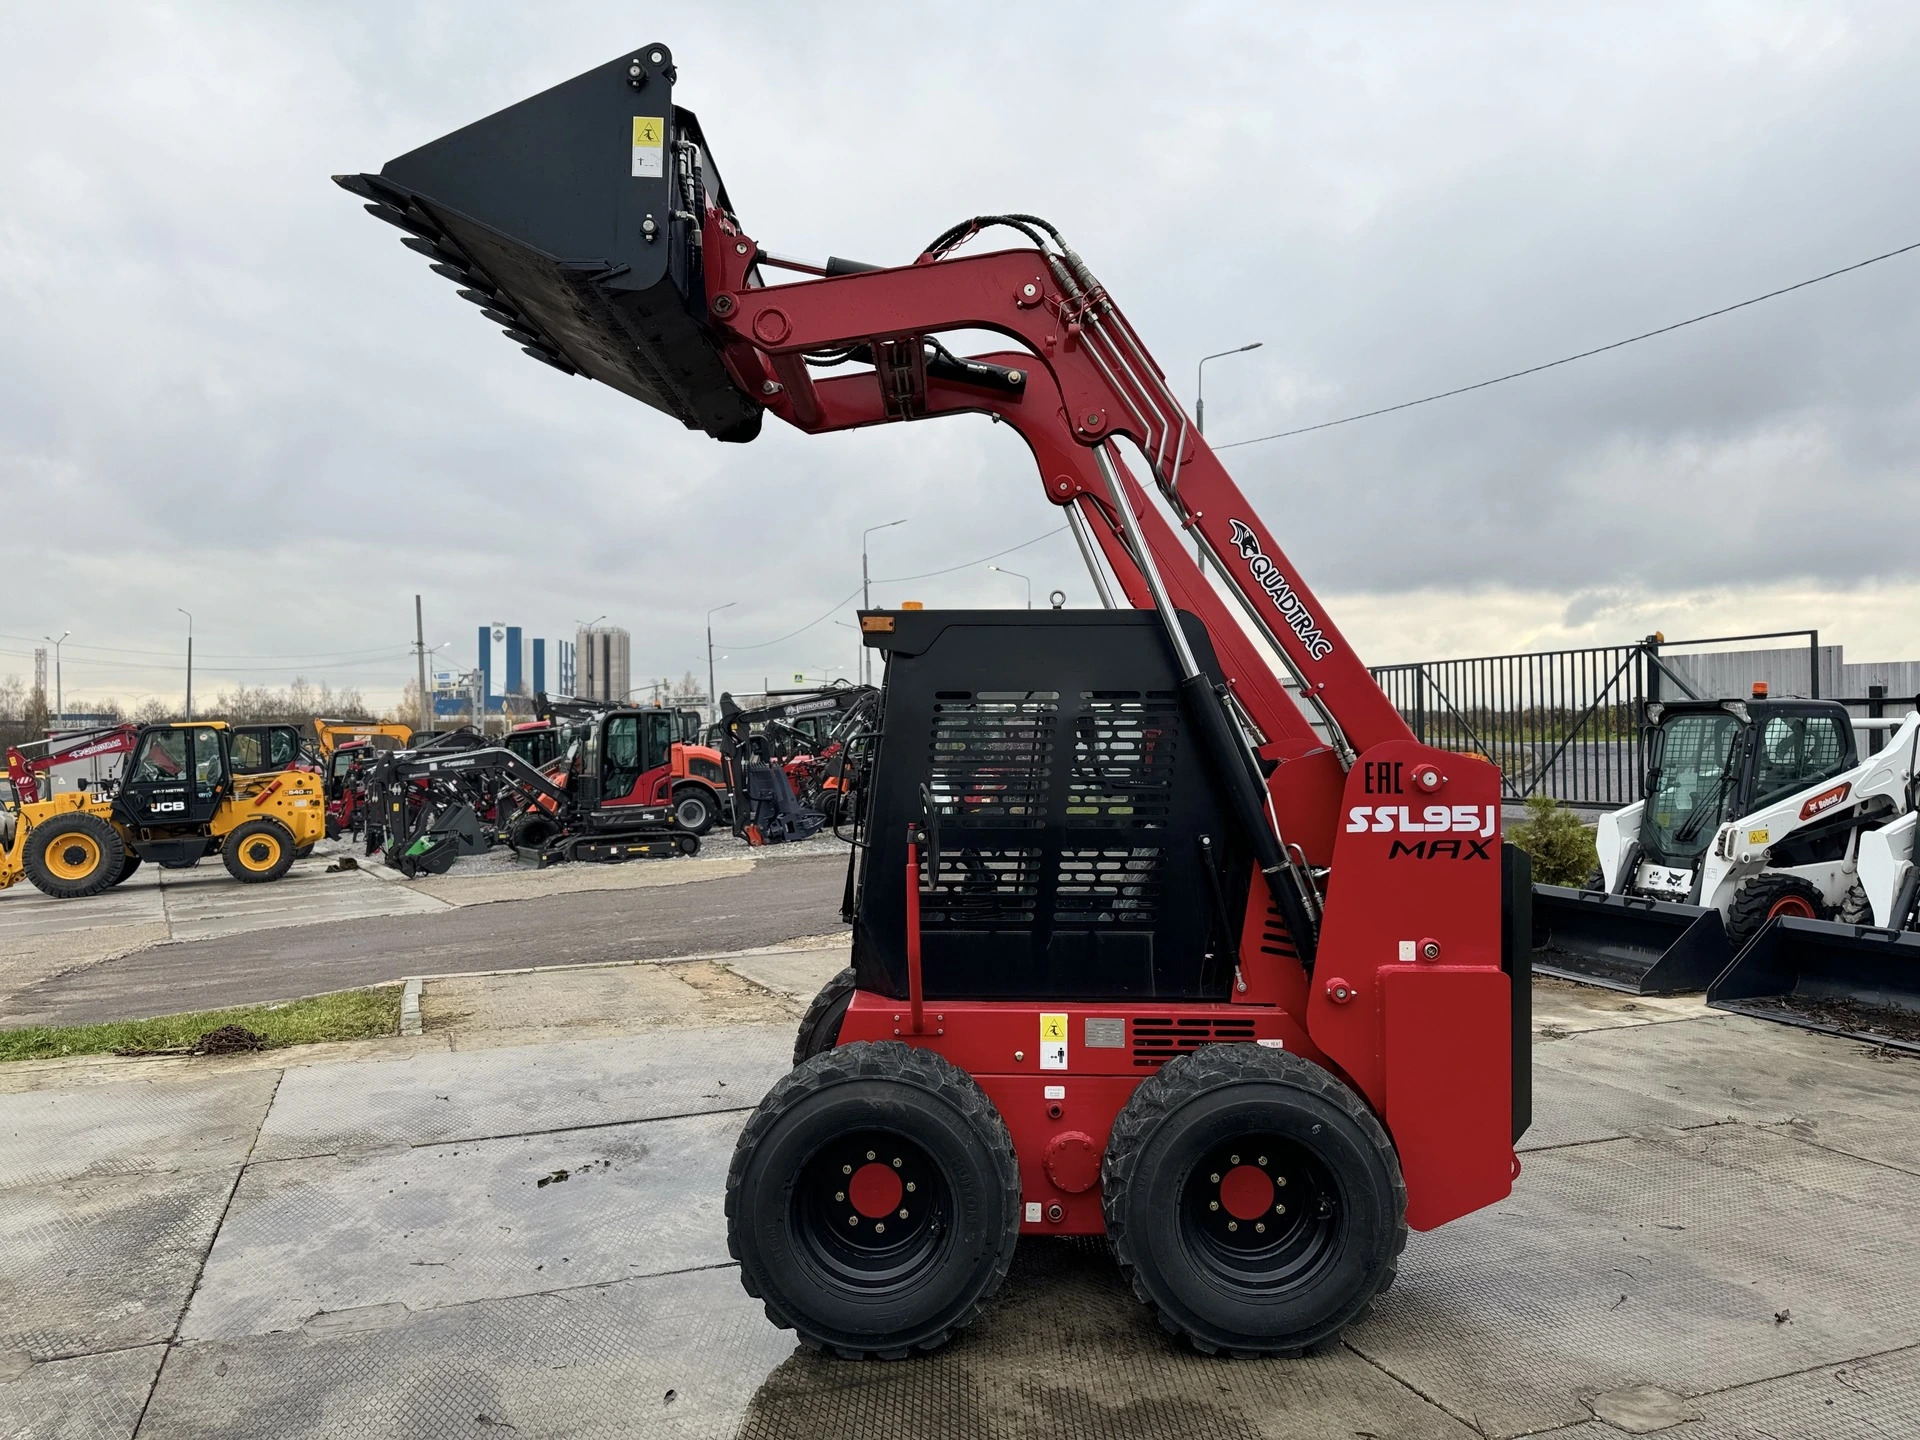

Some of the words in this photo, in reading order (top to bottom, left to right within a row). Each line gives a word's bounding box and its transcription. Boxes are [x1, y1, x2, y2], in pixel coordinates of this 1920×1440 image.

[1250, 555, 1333, 660] QUADTRAC
[798, 699, 836, 711] RHINOCEROS
[1365, 762, 1404, 794] EAC
[92, 792, 115, 803] JC
[151, 801, 185, 812] JCB
[1818, 794, 1838, 809] Bobcat
[1346, 805, 1495, 838] SSL95J
[1388, 838, 1494, 860] MAX
